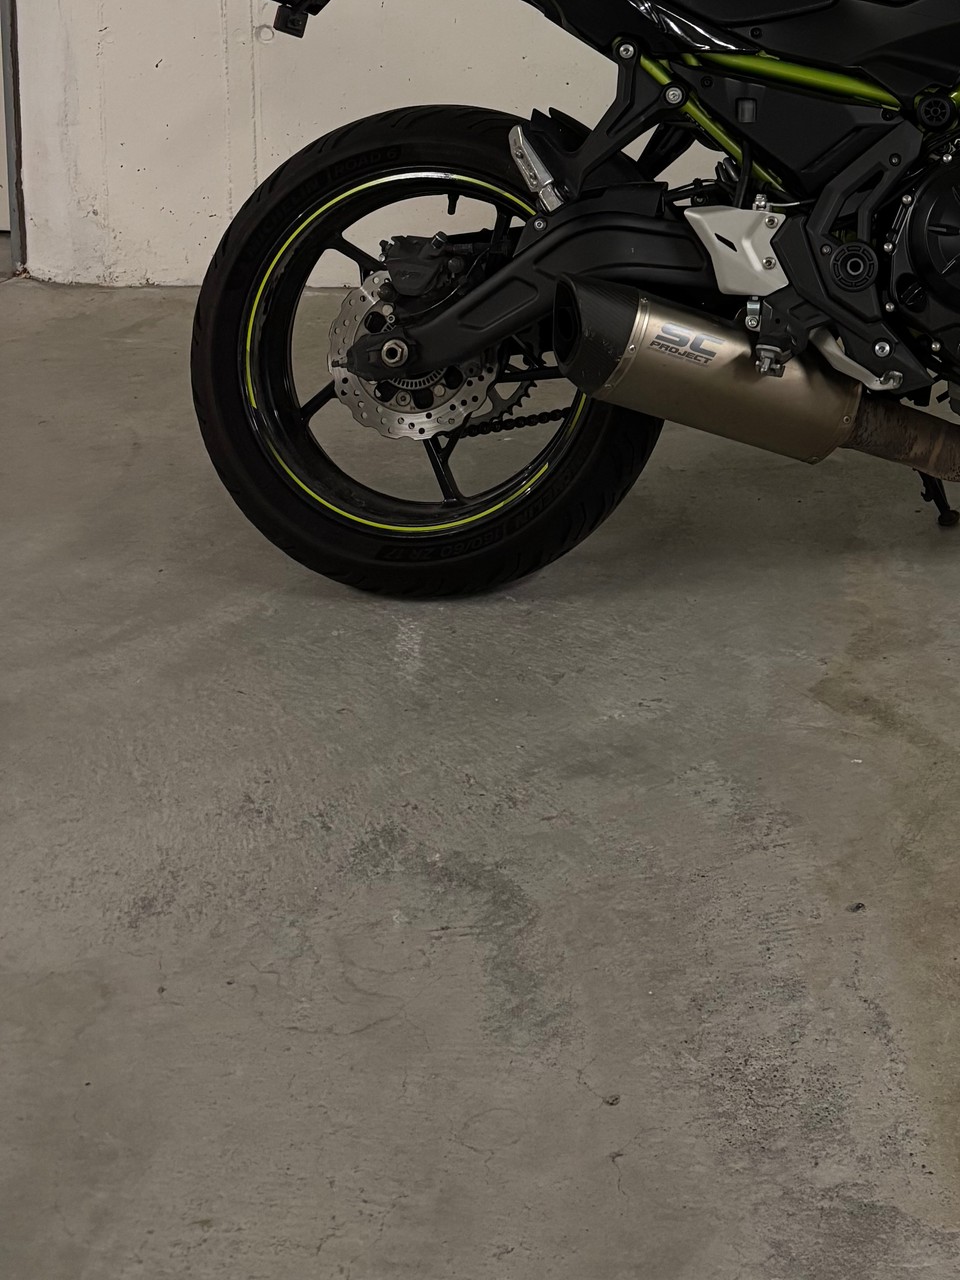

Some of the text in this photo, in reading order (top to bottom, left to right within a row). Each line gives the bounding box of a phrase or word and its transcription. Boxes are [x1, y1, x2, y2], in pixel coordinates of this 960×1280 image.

[332, 150, 382, 177] ROAD
[386, 148, 399, 160] 6
[650, 340, 712, 363] PROJECT
[655, 322, 726, 358] SC
